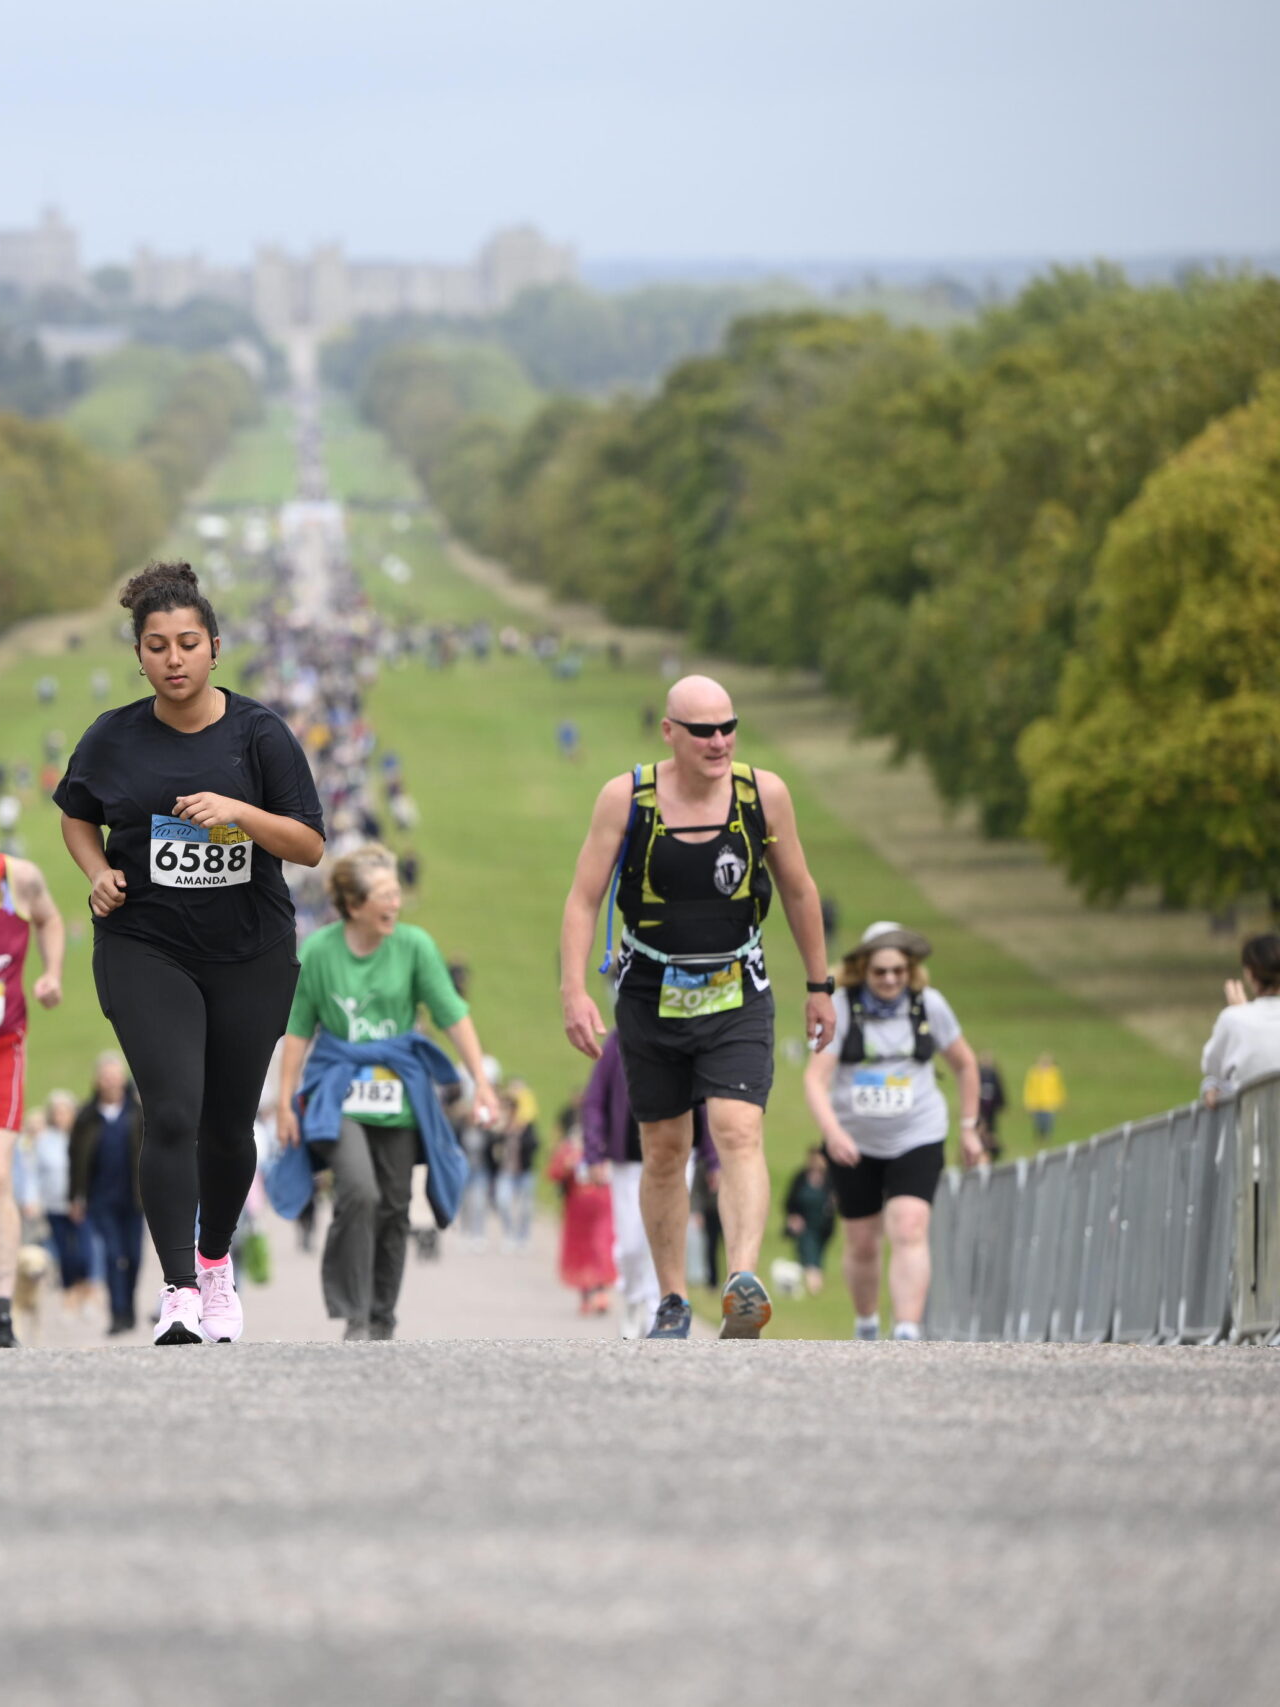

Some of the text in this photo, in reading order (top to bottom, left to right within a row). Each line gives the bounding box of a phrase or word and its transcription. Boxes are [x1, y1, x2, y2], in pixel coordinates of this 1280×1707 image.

[156, 842, 247, 873] 6588
[175, 876, 227, 885] AMANDA
[664, 981, 739, 1008] 2099
